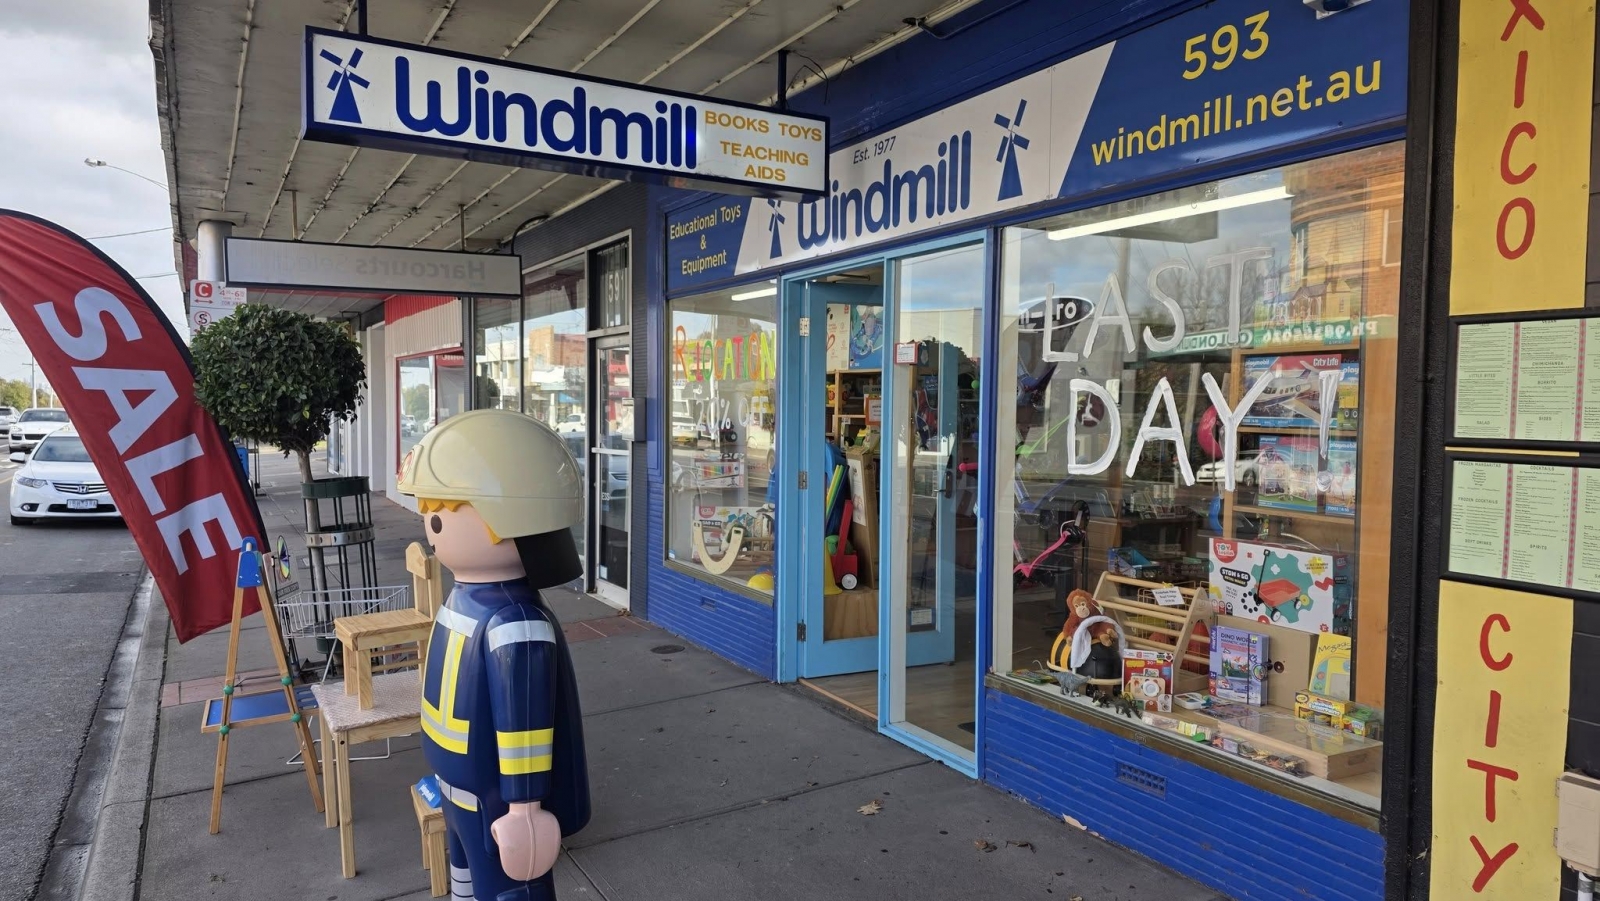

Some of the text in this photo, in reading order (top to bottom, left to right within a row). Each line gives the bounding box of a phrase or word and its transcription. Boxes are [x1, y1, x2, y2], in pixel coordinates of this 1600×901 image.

[1182, 10, 1270, 80] 593
[394, 55, 698, 170] Windmill
[704, 110, 823, 142] BOOKS TOYS
[1091, 60, 1381, 166] windmill.net.au
[719, 140, 809, 167] TEACHING
[853, 135, 897, 165] Est. 1977
[744, 164, 787, 182] AIDS
[798, 129, 972, 252] Windmill
[669, 202, 742, 241] Educational Toys
[699, 238, 708, 251] &
[681, 249, 728, 276] Equipment
[198, 283, 210, 297] C
[608, 270, 625, 303] 591
[1042, 246, 1276, 363] LAST
[673, 324, 775, 383] RELOCATION
[1313, 357, 1339, 367] City Life
[737, 396, 768, 428] OFF
[33, 286, 244, 576] SALE
[1068, 370, 1275, 492] DAY
[1221, 568, 1237, 578] STOW
[1221, 632, 1235, 640] DINO
[1466, 613, 1519, 893] CITY
